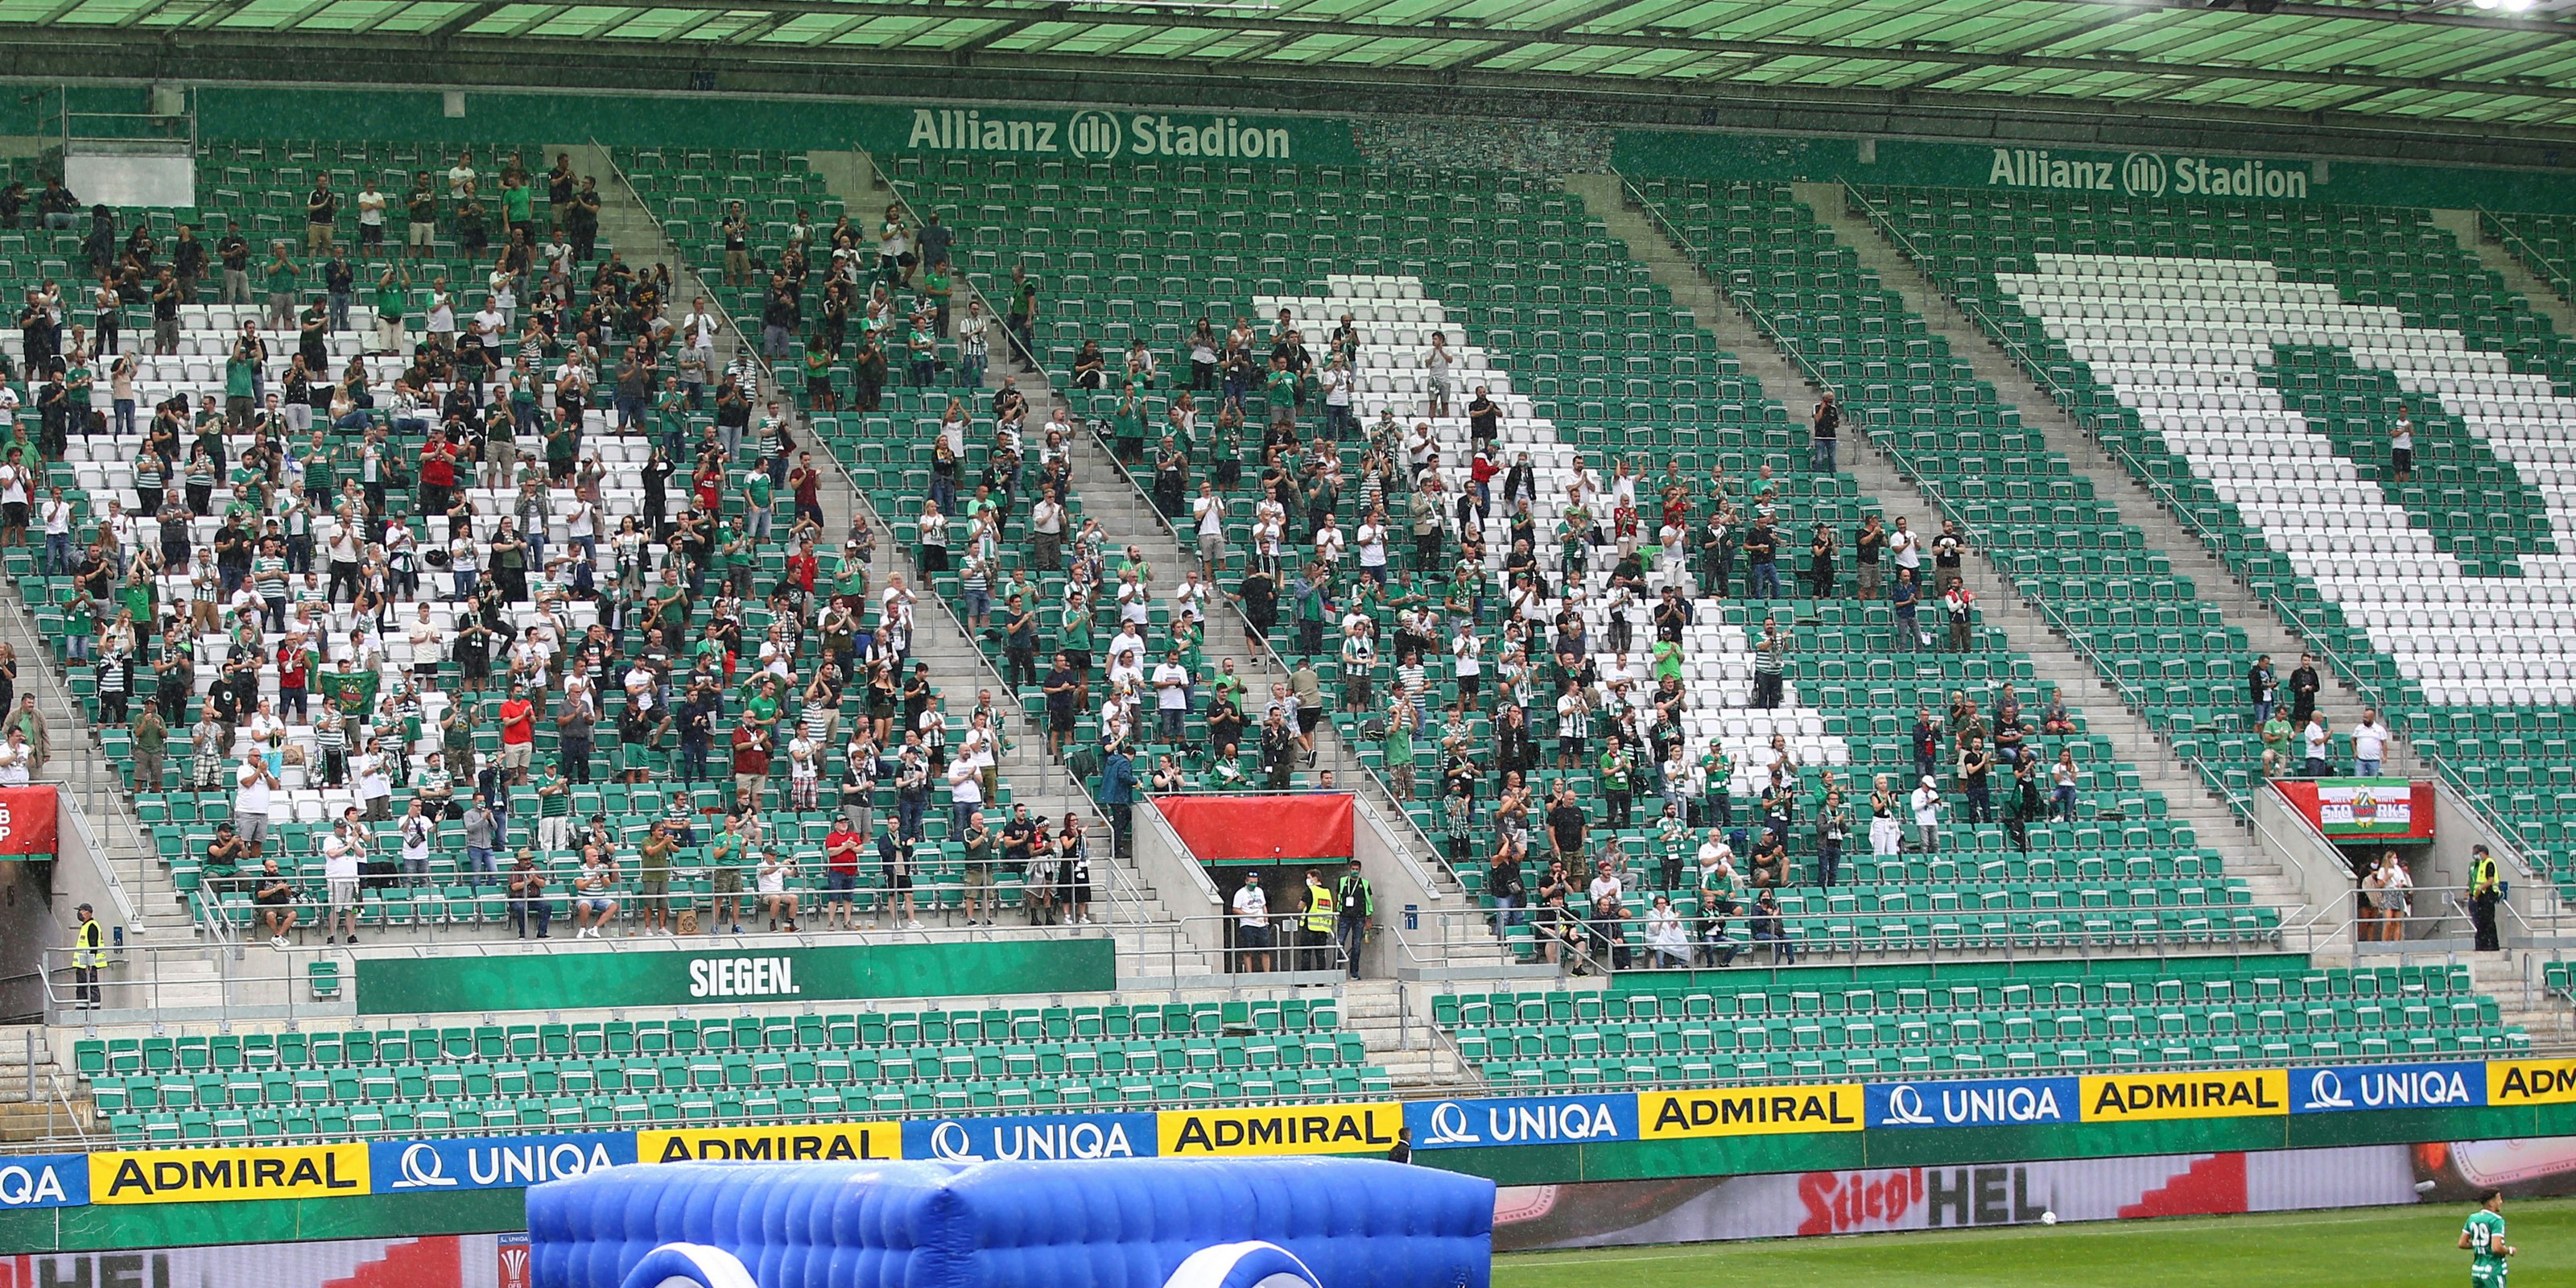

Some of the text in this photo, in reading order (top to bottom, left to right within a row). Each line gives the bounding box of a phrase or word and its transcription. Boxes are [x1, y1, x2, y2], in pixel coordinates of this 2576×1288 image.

[907, 109, 1057, 153] Allianz
[1131, 114, 1290, 159] Stadion
[1988, 148, 2307, 199] Allianz Stadion
[689, 956, 800, 997] SIEGEN.
[1942, 1086, 2062, 1124] UNIQA
[2093, 1076, 2280, 1115] ADMIRAL
[2360, 1070, 2471, 1106] UNIQA
[1173, 1110, 1393, 1153] ADMIRAL
[1489, 1103, 1619, 1142] UNIQA
[1653, 1091, 1855, 1132] ADMIRAL
[658, 1129, 890, 1164] ADMIRAL
[993, 1121, 1133, 1161] UNIQA
[107, 1151, 357, 1197] ADMIRAL
[468, 1141, 614, 1185] UNIQA
[1797, 1166, 1924, 1236] Stiegl
[2470, 1221, 2490, 1247] 29
